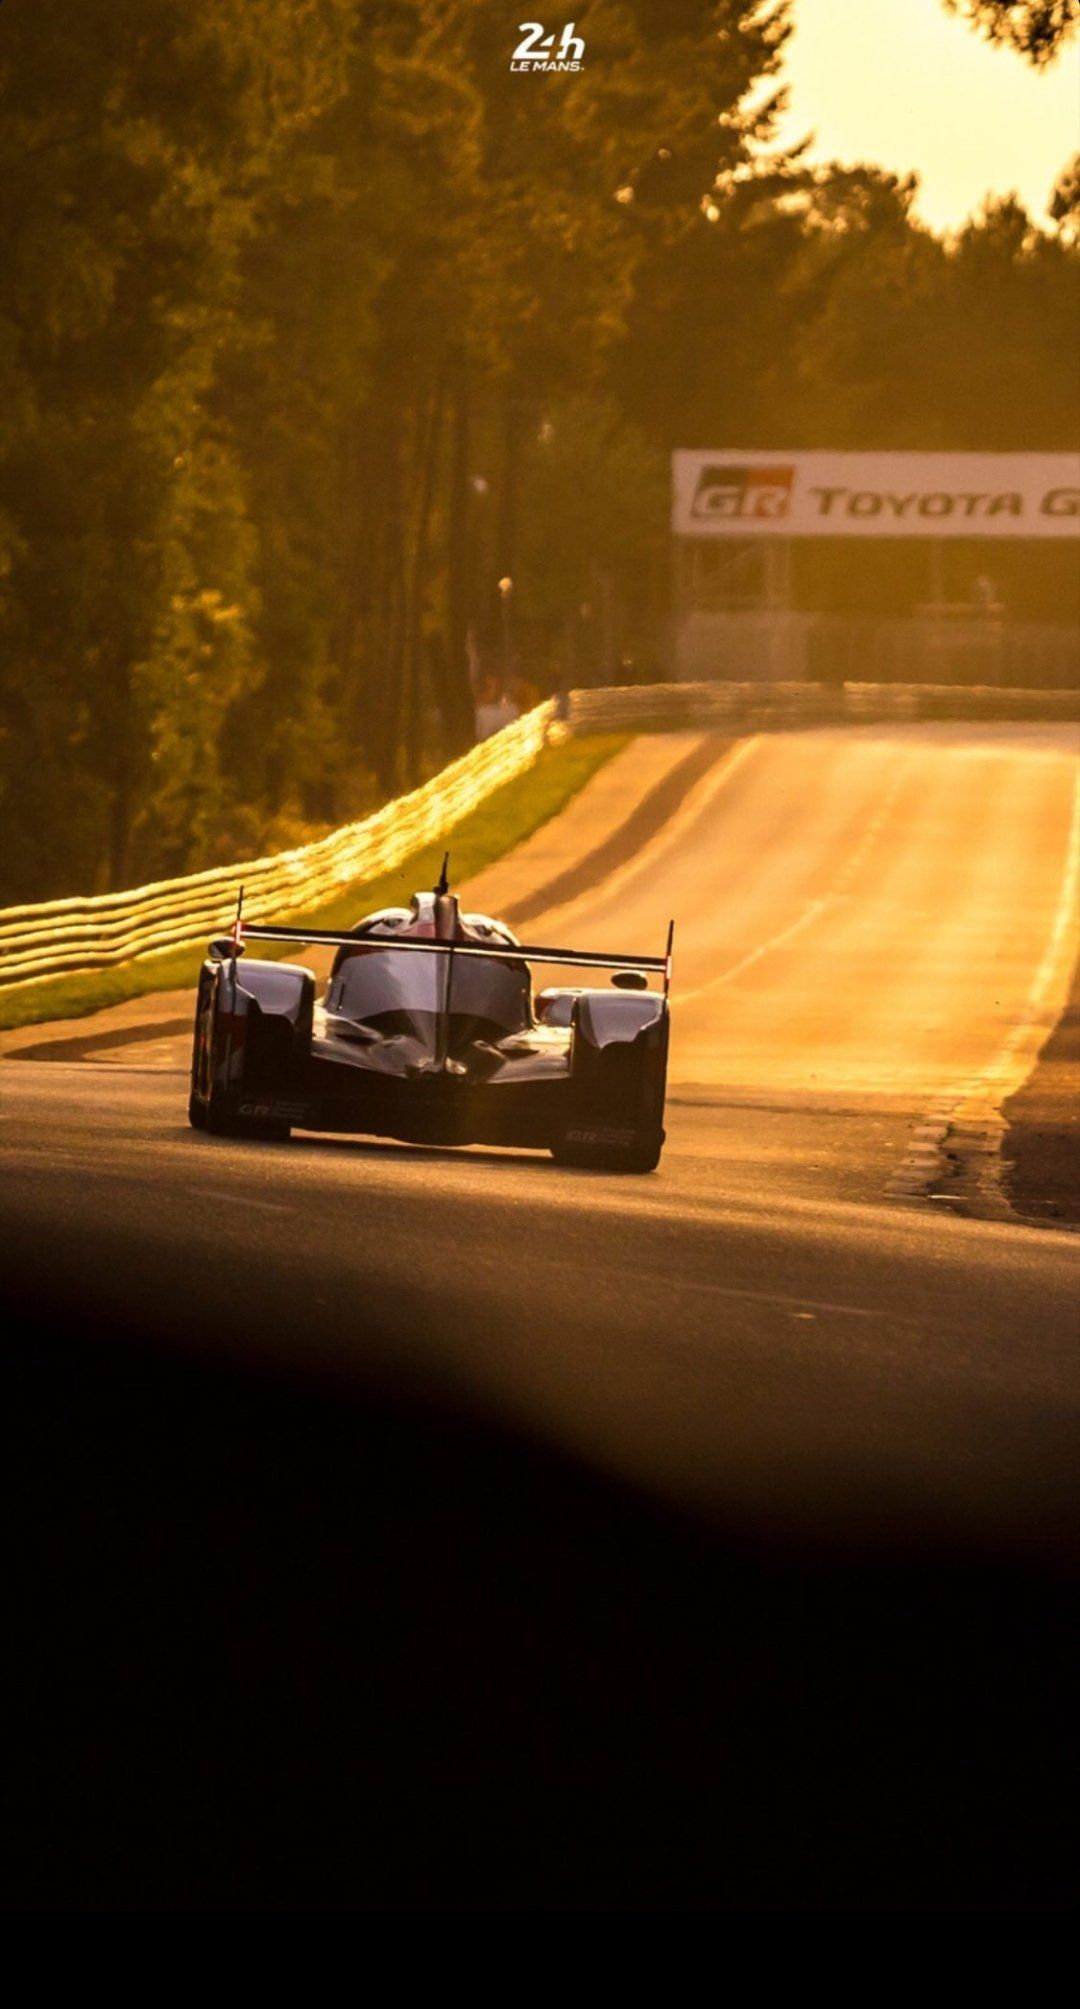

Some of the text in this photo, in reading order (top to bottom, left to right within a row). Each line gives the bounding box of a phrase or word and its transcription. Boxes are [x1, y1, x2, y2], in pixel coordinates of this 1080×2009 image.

[694, 485, 791, 518] GR
[808, 487, 1023, 518] TOYOTA
[239, 1103, 271, 1116] GR
